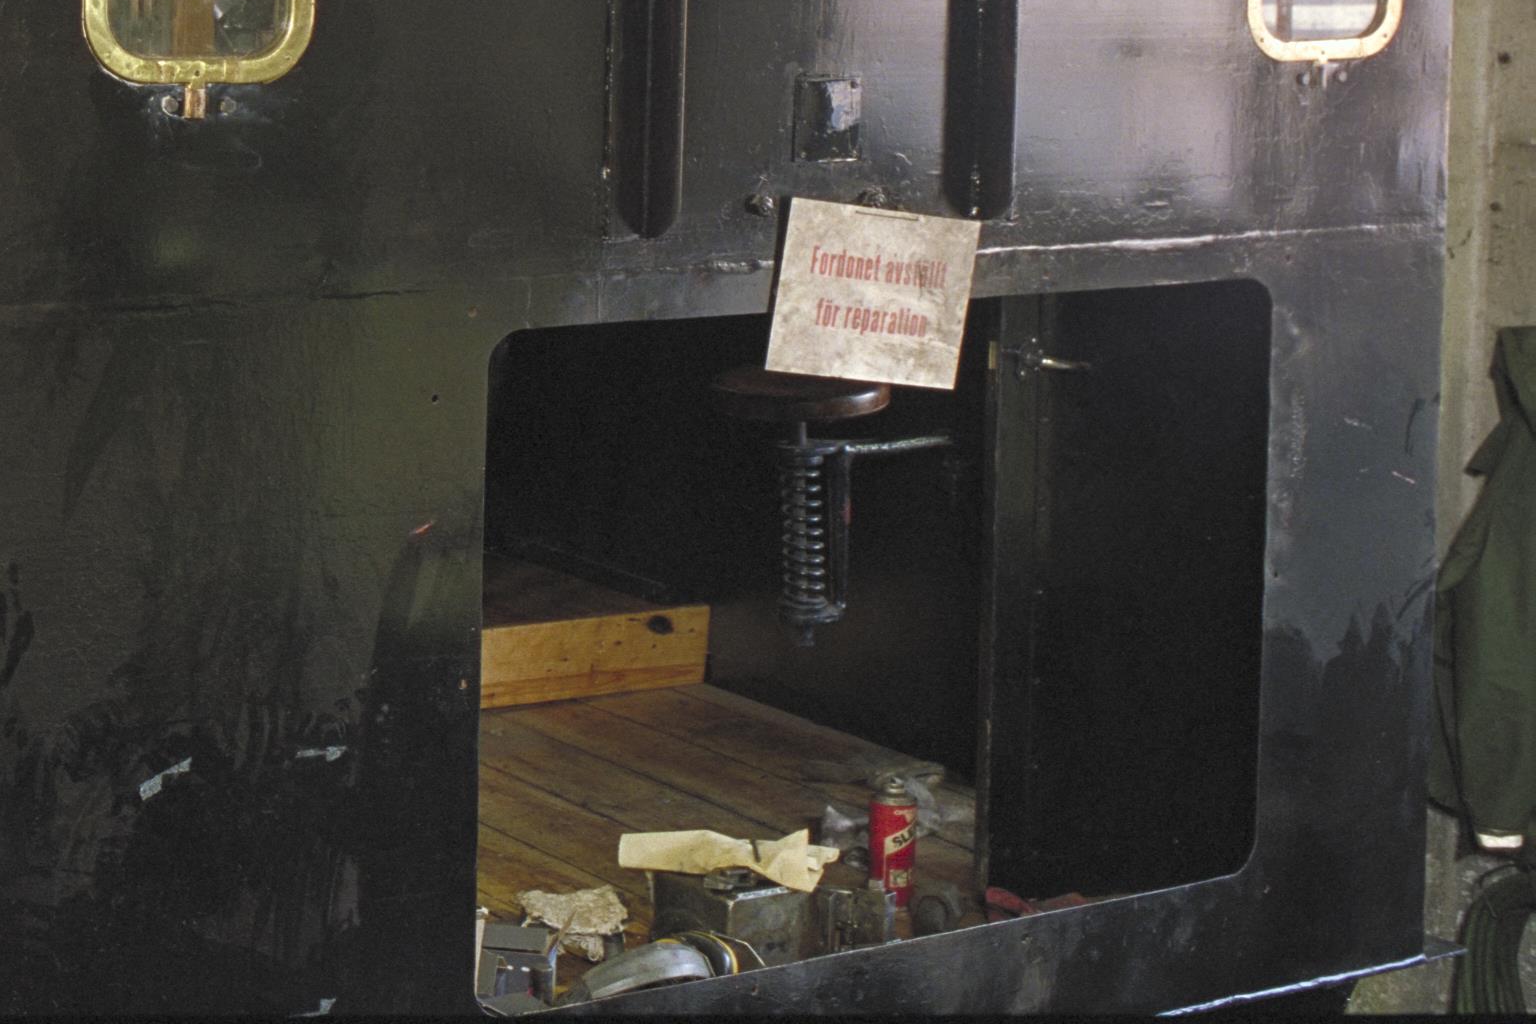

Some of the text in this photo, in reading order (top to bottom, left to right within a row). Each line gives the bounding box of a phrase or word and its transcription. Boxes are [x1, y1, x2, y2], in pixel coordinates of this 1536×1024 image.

[810, 245, 948, 289] Fordonet avställt
[815, 297, 928, 337] för reparation
